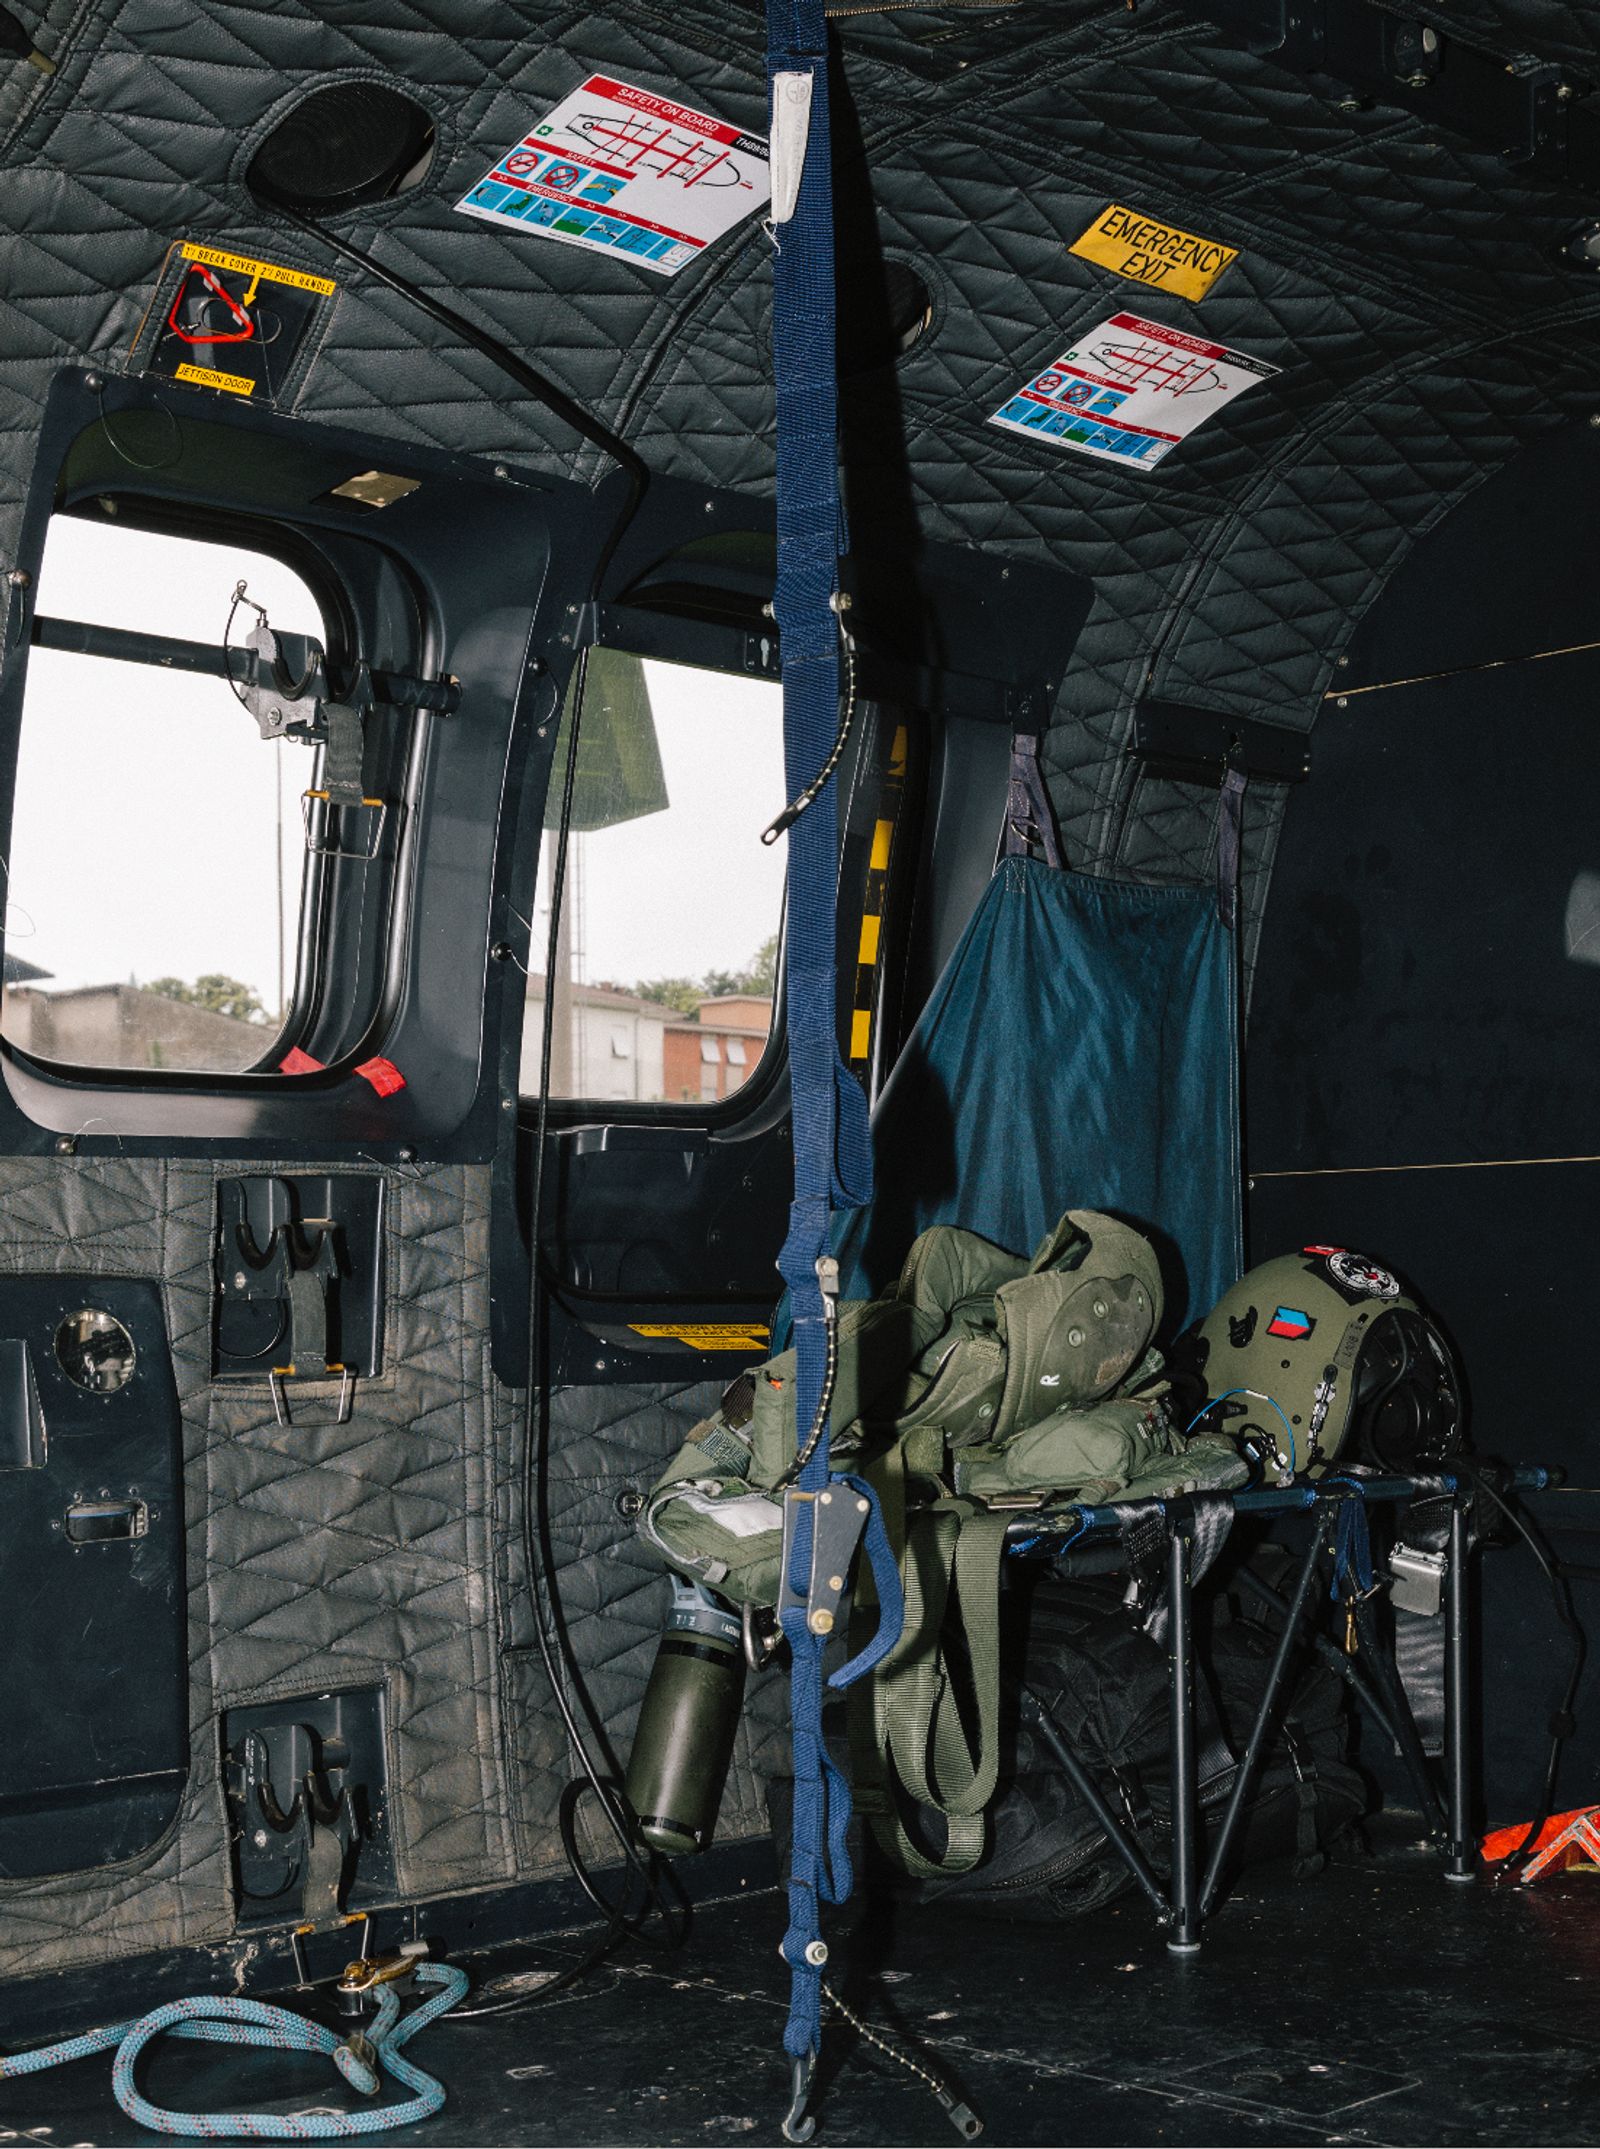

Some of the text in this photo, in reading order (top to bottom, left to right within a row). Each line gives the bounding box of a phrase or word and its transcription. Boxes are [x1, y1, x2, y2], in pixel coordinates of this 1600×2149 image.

[618, 88, 662, 109] SAFETY
[662, 104, 680, 117] ON
[679, 109, 719, 132] BOARD
[565, 151, 596, 167] SAFETY
[525, 184, 578, 204] EMERGENCY
[1098, 210, 1234, 276] EMERGENCY
[197, 248, 225, 265] BREAK
[229, 258, 257, 274] COVER
[274, 270, 295, 284] PULL
[298, 276, 332, 294] HANDLE
[1120, 251, 1177, 283] EXIT
[178, 365, 252, 391] JETTISON DOOR
[1040, 1374, 1060, 1387] R
